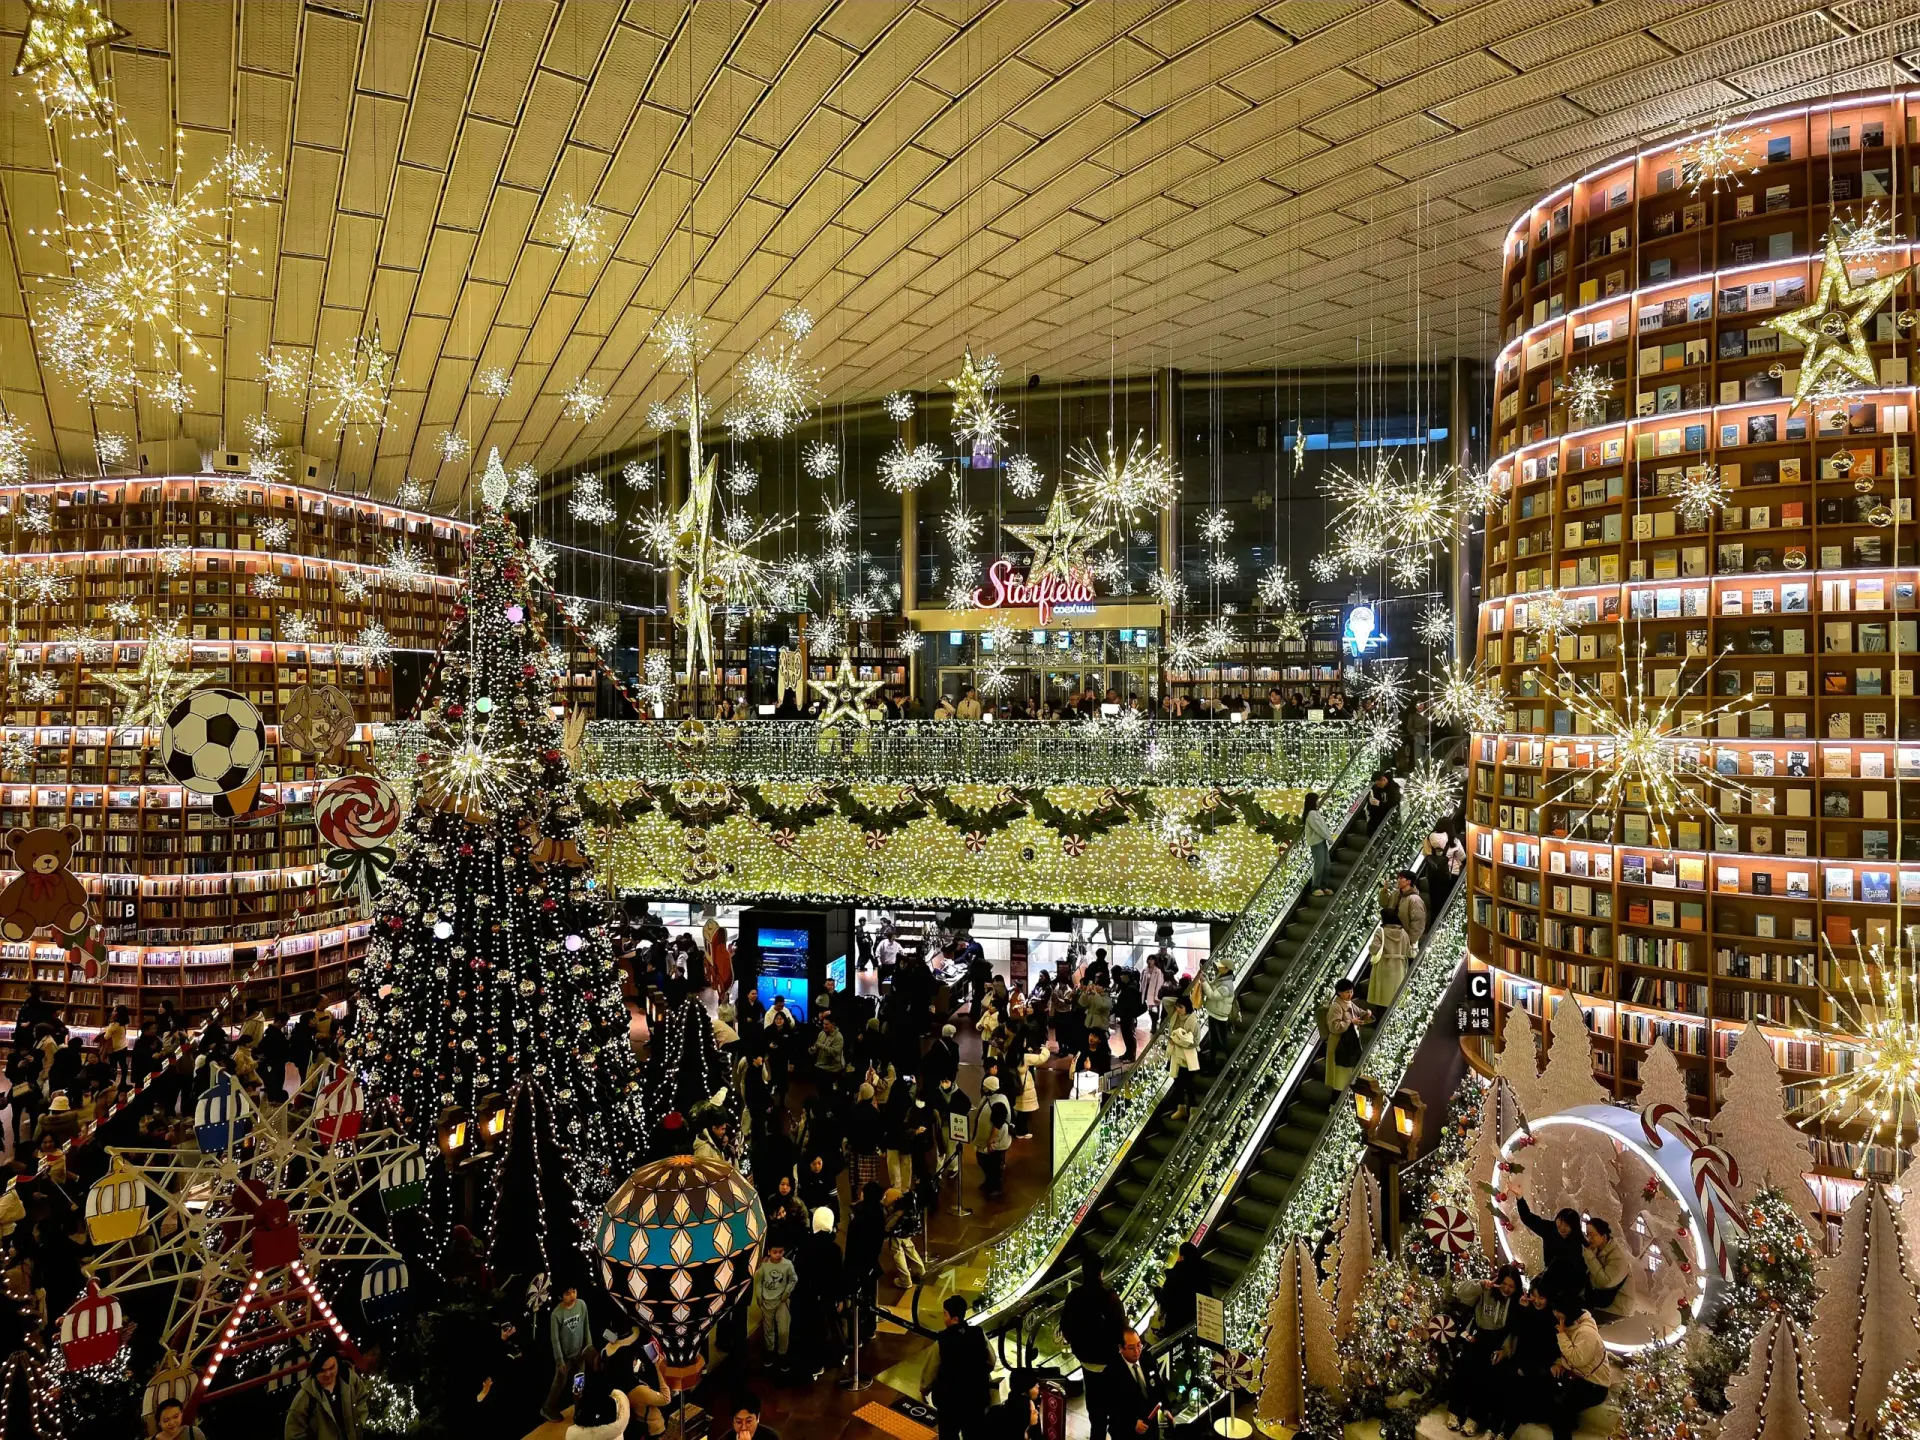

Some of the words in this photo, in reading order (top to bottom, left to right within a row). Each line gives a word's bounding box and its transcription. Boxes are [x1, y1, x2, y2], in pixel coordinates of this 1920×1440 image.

[973, 560, 1094, 626] Starfield
[125, 903, 135, 918] B
[1471, 976, 1487, 997] C
[1471, 1007, 1489, 1017] 취미
[1471, 1018, 1489, 1028] 실용
[953, 1125, 964, 1133] Exit
